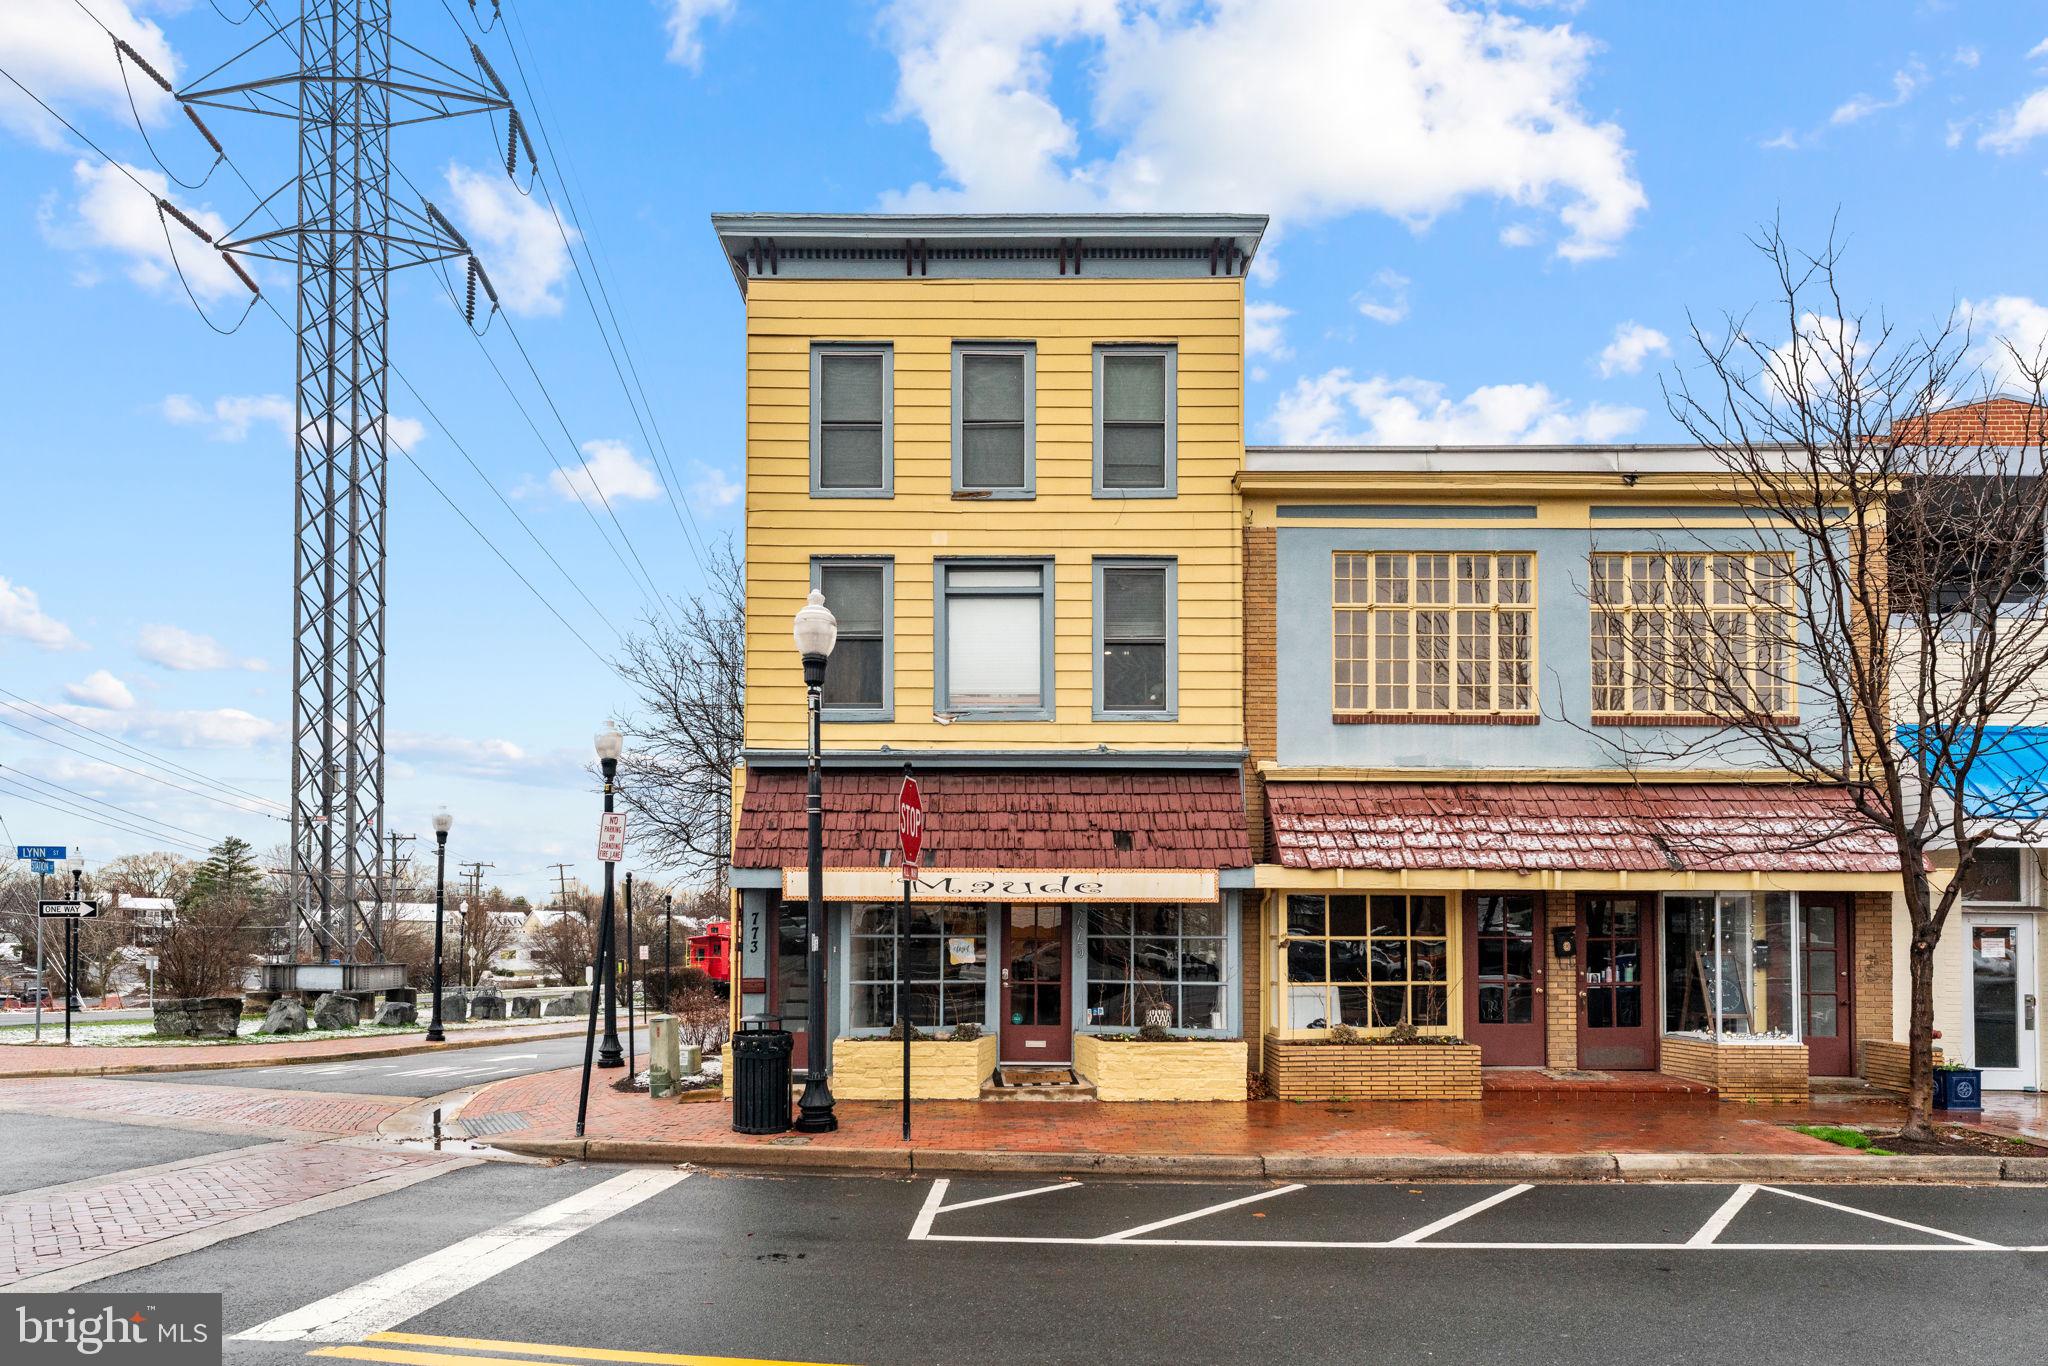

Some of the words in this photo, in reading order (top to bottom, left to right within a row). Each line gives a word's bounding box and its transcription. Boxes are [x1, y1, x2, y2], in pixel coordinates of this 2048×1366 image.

[609, 816, 619, 825] NO
[900, 802, 921, 838] STOP
[604, 825, 622, 834] PARKING
[608, 834, 616, 842] OR
[600, 841, 622, 850] STANDING
[22, 847, 46, 858] LYNN
[599, 849, 609, 858] FIRE
[610, 850, 621, 859] LANE
[31, 861, 49, 872] STATION
[896, 875, 1104, 895] Maude
[45, 905, 61, 913] ONE
[63, 905, 80, 913] WAY
[750, 911, 760, 954] 773
